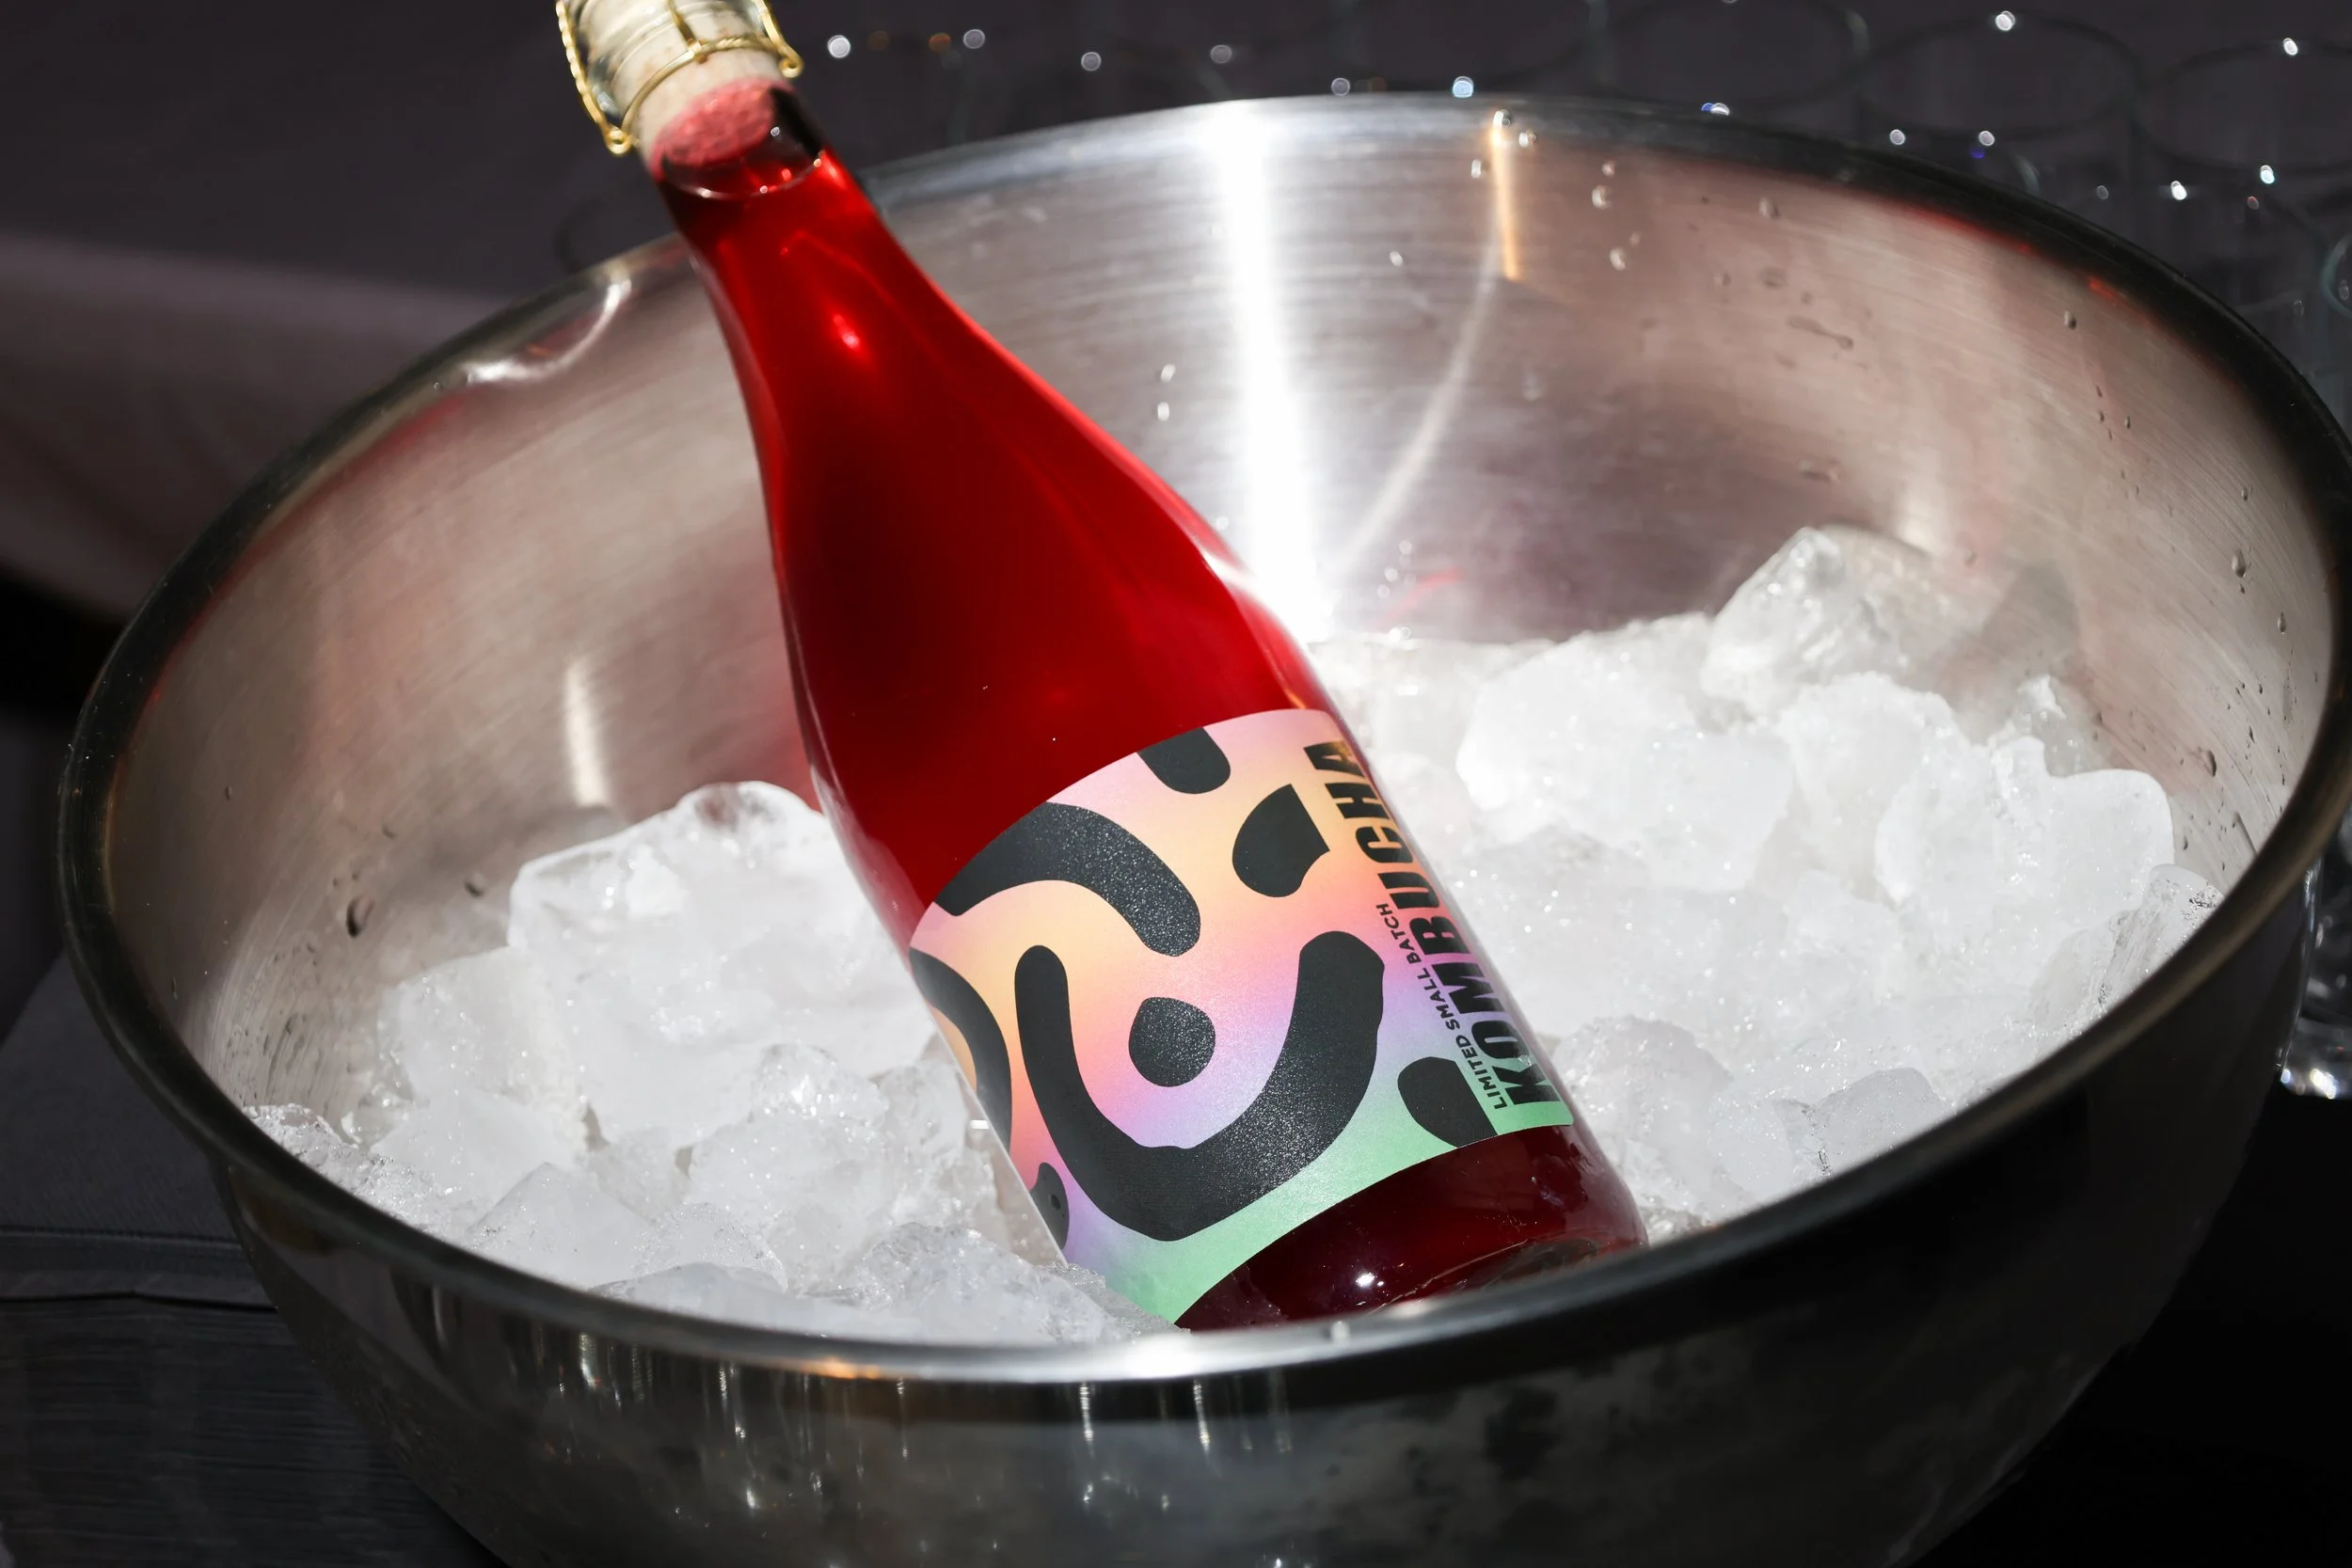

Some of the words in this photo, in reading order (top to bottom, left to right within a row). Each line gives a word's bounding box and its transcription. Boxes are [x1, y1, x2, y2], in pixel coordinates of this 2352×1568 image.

[1303, 741, 1561, 1105] KOMBUCHA
[1375, 903, 1422, 964] BATCH
[1417, 967, 1461, 1031] SMALL
[1455, 1035, 1508, 1109] LIMITED
